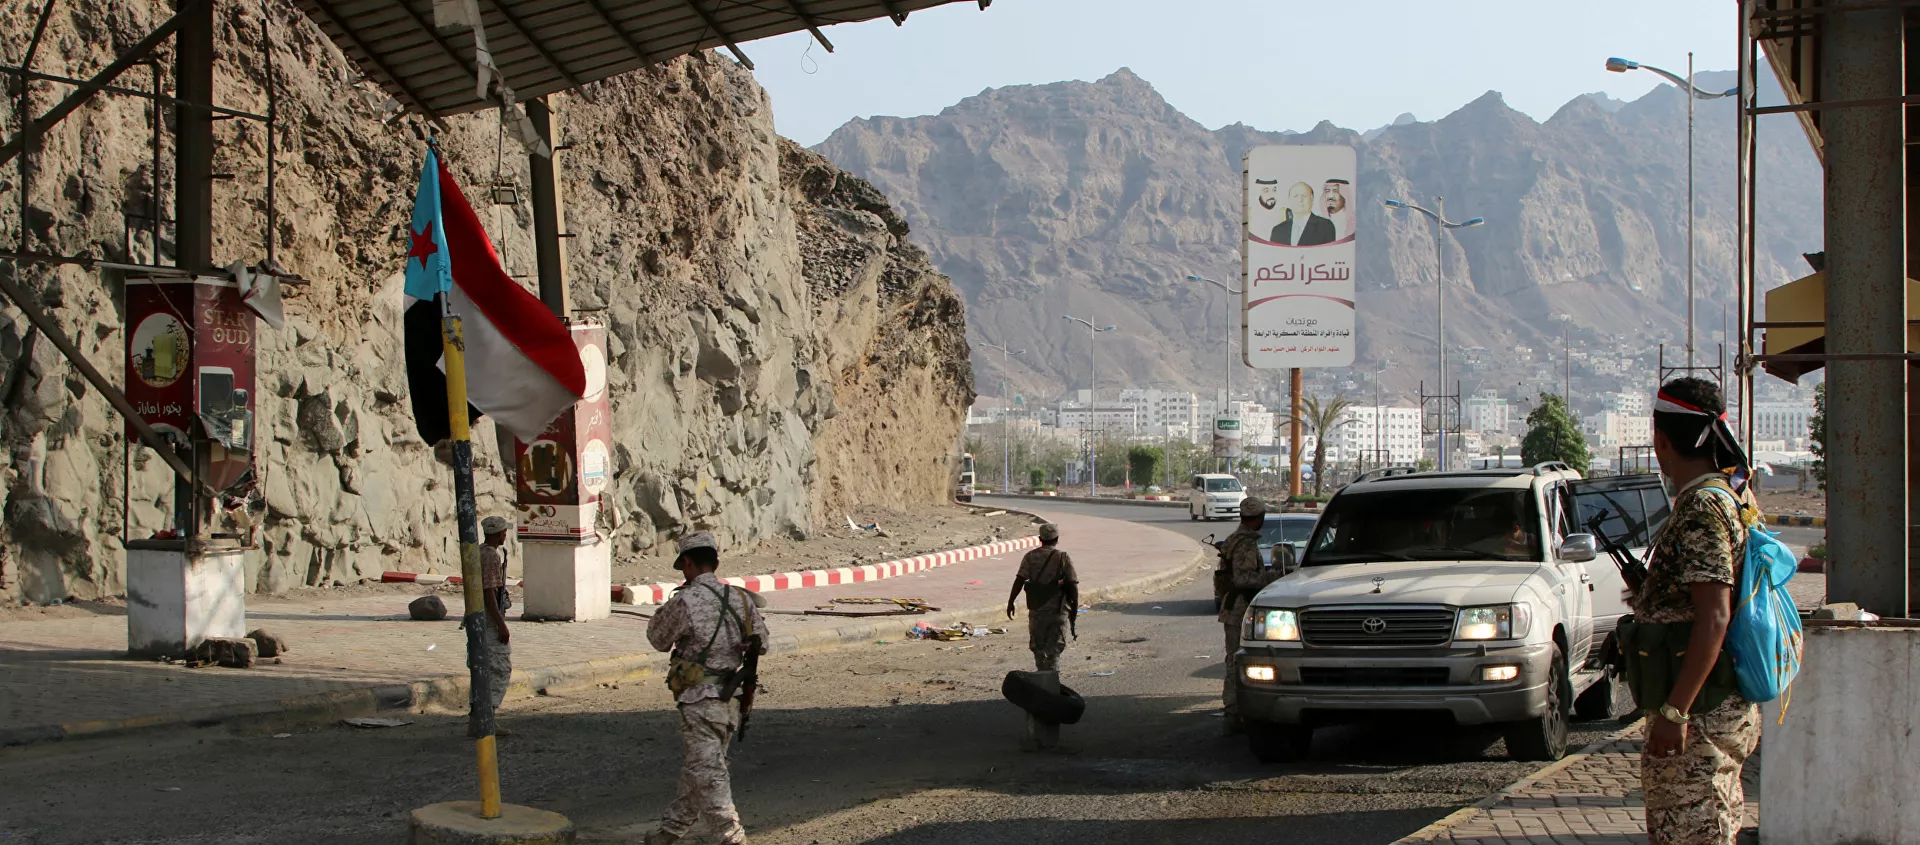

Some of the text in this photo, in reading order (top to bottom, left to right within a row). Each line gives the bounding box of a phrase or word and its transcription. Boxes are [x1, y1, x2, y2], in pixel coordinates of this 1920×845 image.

[1254, 263, 1295, 287] لكم
[203, 309, 249, 330] STAR
[1286, 317, 1318, 327] مع تحيات
[212, 327, 250, 345] OUD
[1254, 330, 1272, 338] الرابعة
[1272, 330, 1299, 338] العسكرية
[1336, 330, 1350, 338] قيادة
